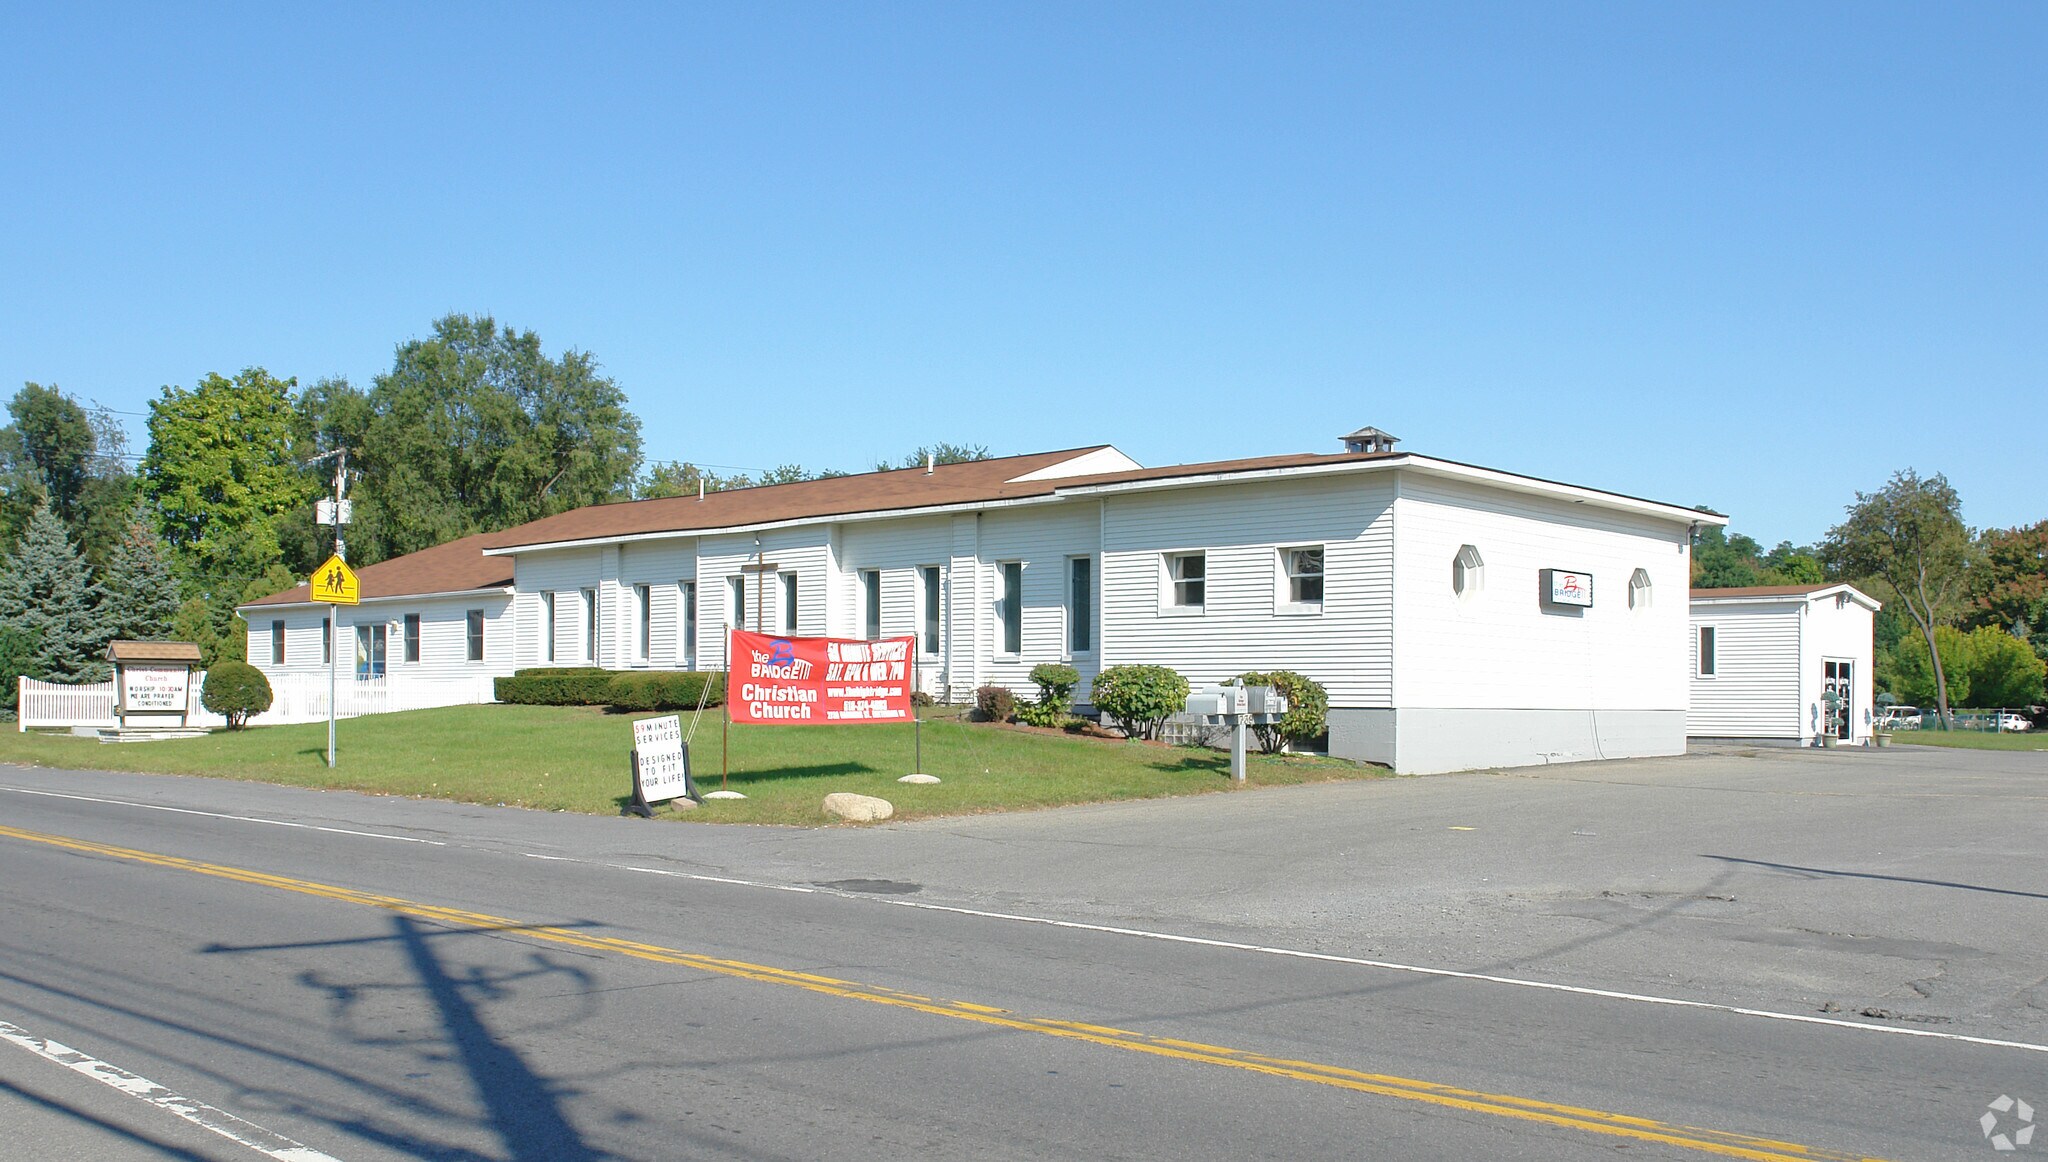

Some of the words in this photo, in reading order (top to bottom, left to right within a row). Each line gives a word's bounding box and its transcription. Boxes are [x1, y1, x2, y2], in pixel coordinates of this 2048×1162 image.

[149, 666, 186, 674] Community
[825, 663, 844, 682] SAT.
[741, 683, 818, 703] Christian
[749, 701, 812, 719] Church
[636, 730, 680, 744] SERVICES
[640, 752, 682, 766] DESIGNED
[645, 767, 656, 776] TO
[662, 763, 676, 773] FIT
[641, 777, 659, 787] YOUR
